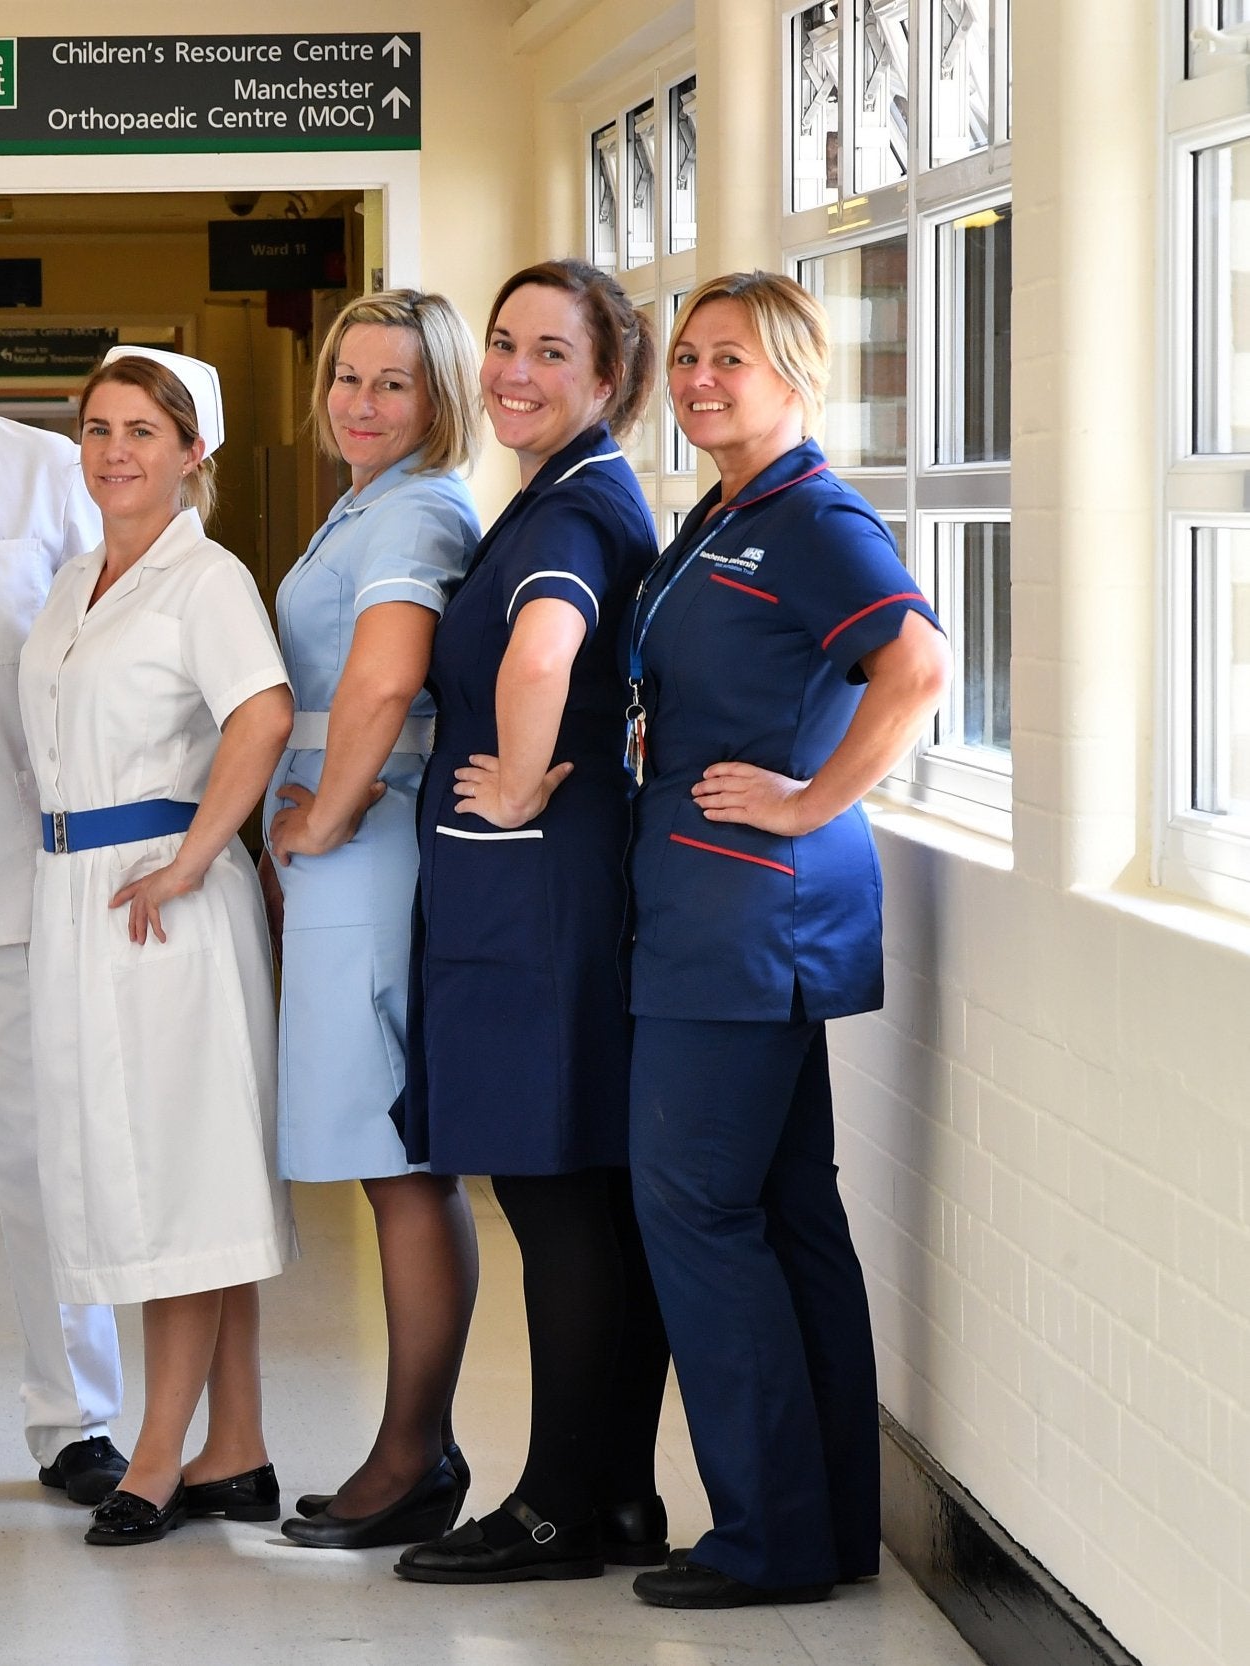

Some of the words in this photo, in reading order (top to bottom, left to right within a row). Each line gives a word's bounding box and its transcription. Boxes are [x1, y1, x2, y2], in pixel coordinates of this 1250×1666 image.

[52, 42, 165, 64] Children's
[175, 41, 282, 63] Resource
[293, 40, 374, 61] Centre
[234, 77, 374, 100] Manchester
[48, 107, 198, 134] Orthopaedic
[207, 107, 288, 129] Centre
[298, 105, 375, 132] (MOC)
[251, 243, 289, 256] Ward
[295, 244, 307, 255] 11
[741, 547, 764, 562] NHS
